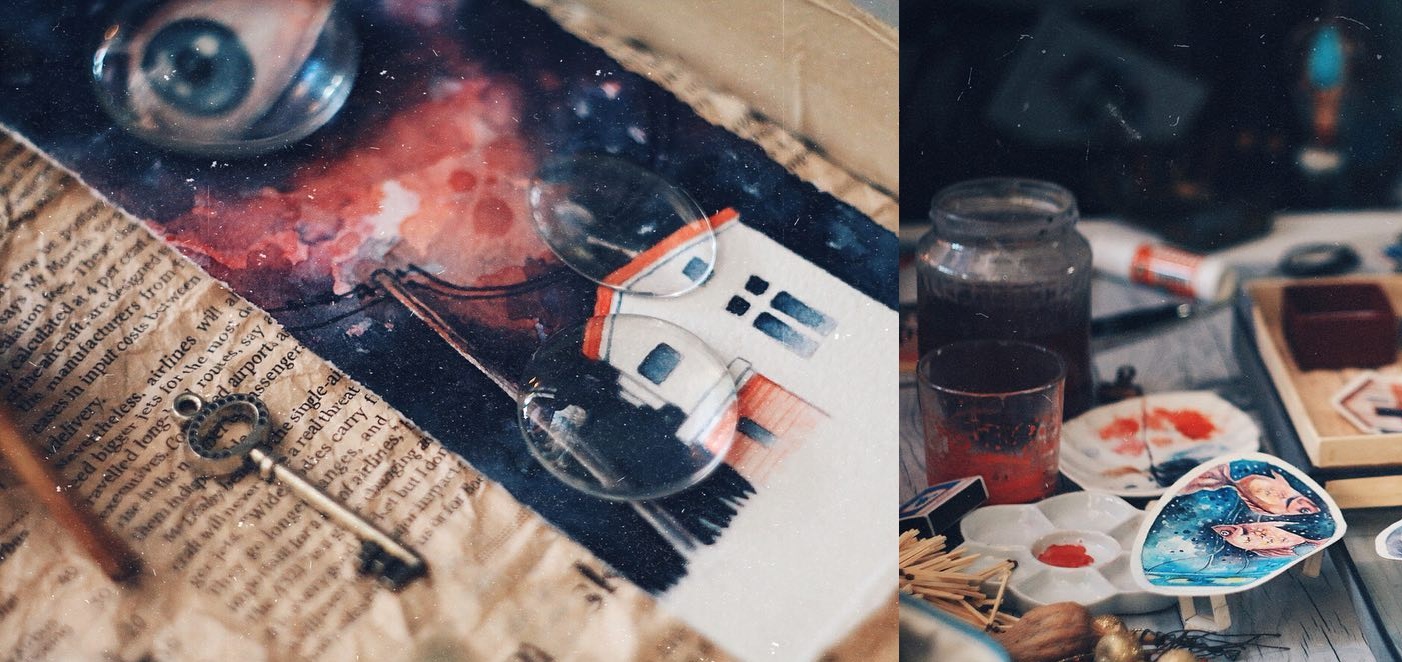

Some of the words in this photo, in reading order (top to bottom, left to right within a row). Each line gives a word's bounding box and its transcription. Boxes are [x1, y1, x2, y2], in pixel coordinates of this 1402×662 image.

[4, 300, 76, 370] calculated
[96, 264, 121, 289] per
[88, 300, 109, 320] are
[105, 251, 162, 307] designed
[42, 297, 140, 392] manufacturers
[139, 266, 175, 301] from
[63, 381, 83, 401] in
[78, 348, 120, 388] input
[114, 318, 150, 352] costs
[144, 270, 200, 324] between
[142, 333, 197, 385] airlines
[193, 304, 223, 333] will
[80, 447, 140, 505] ravelled
[194, 342, 242, 389] routes,
[240, 325, 266, 349] say
[91, 418, 140, 466] bigger
[134, 393, 165, 423] jets
[160, 372, 183, 395] for
[181, 351, 208, 377] the
[152, 466, 178, 491] the
[244, 341, 308, 403] assengers
[293, 417, 322, 446] real
[317, 382, 360, 423] threat
[329, 407, 369, 445] carry
[288, 445, 299, 456] a
[313, 443, 365, 493] anges,
[357, 412, 388, 442] and
[393, 473, 420, 499] but
